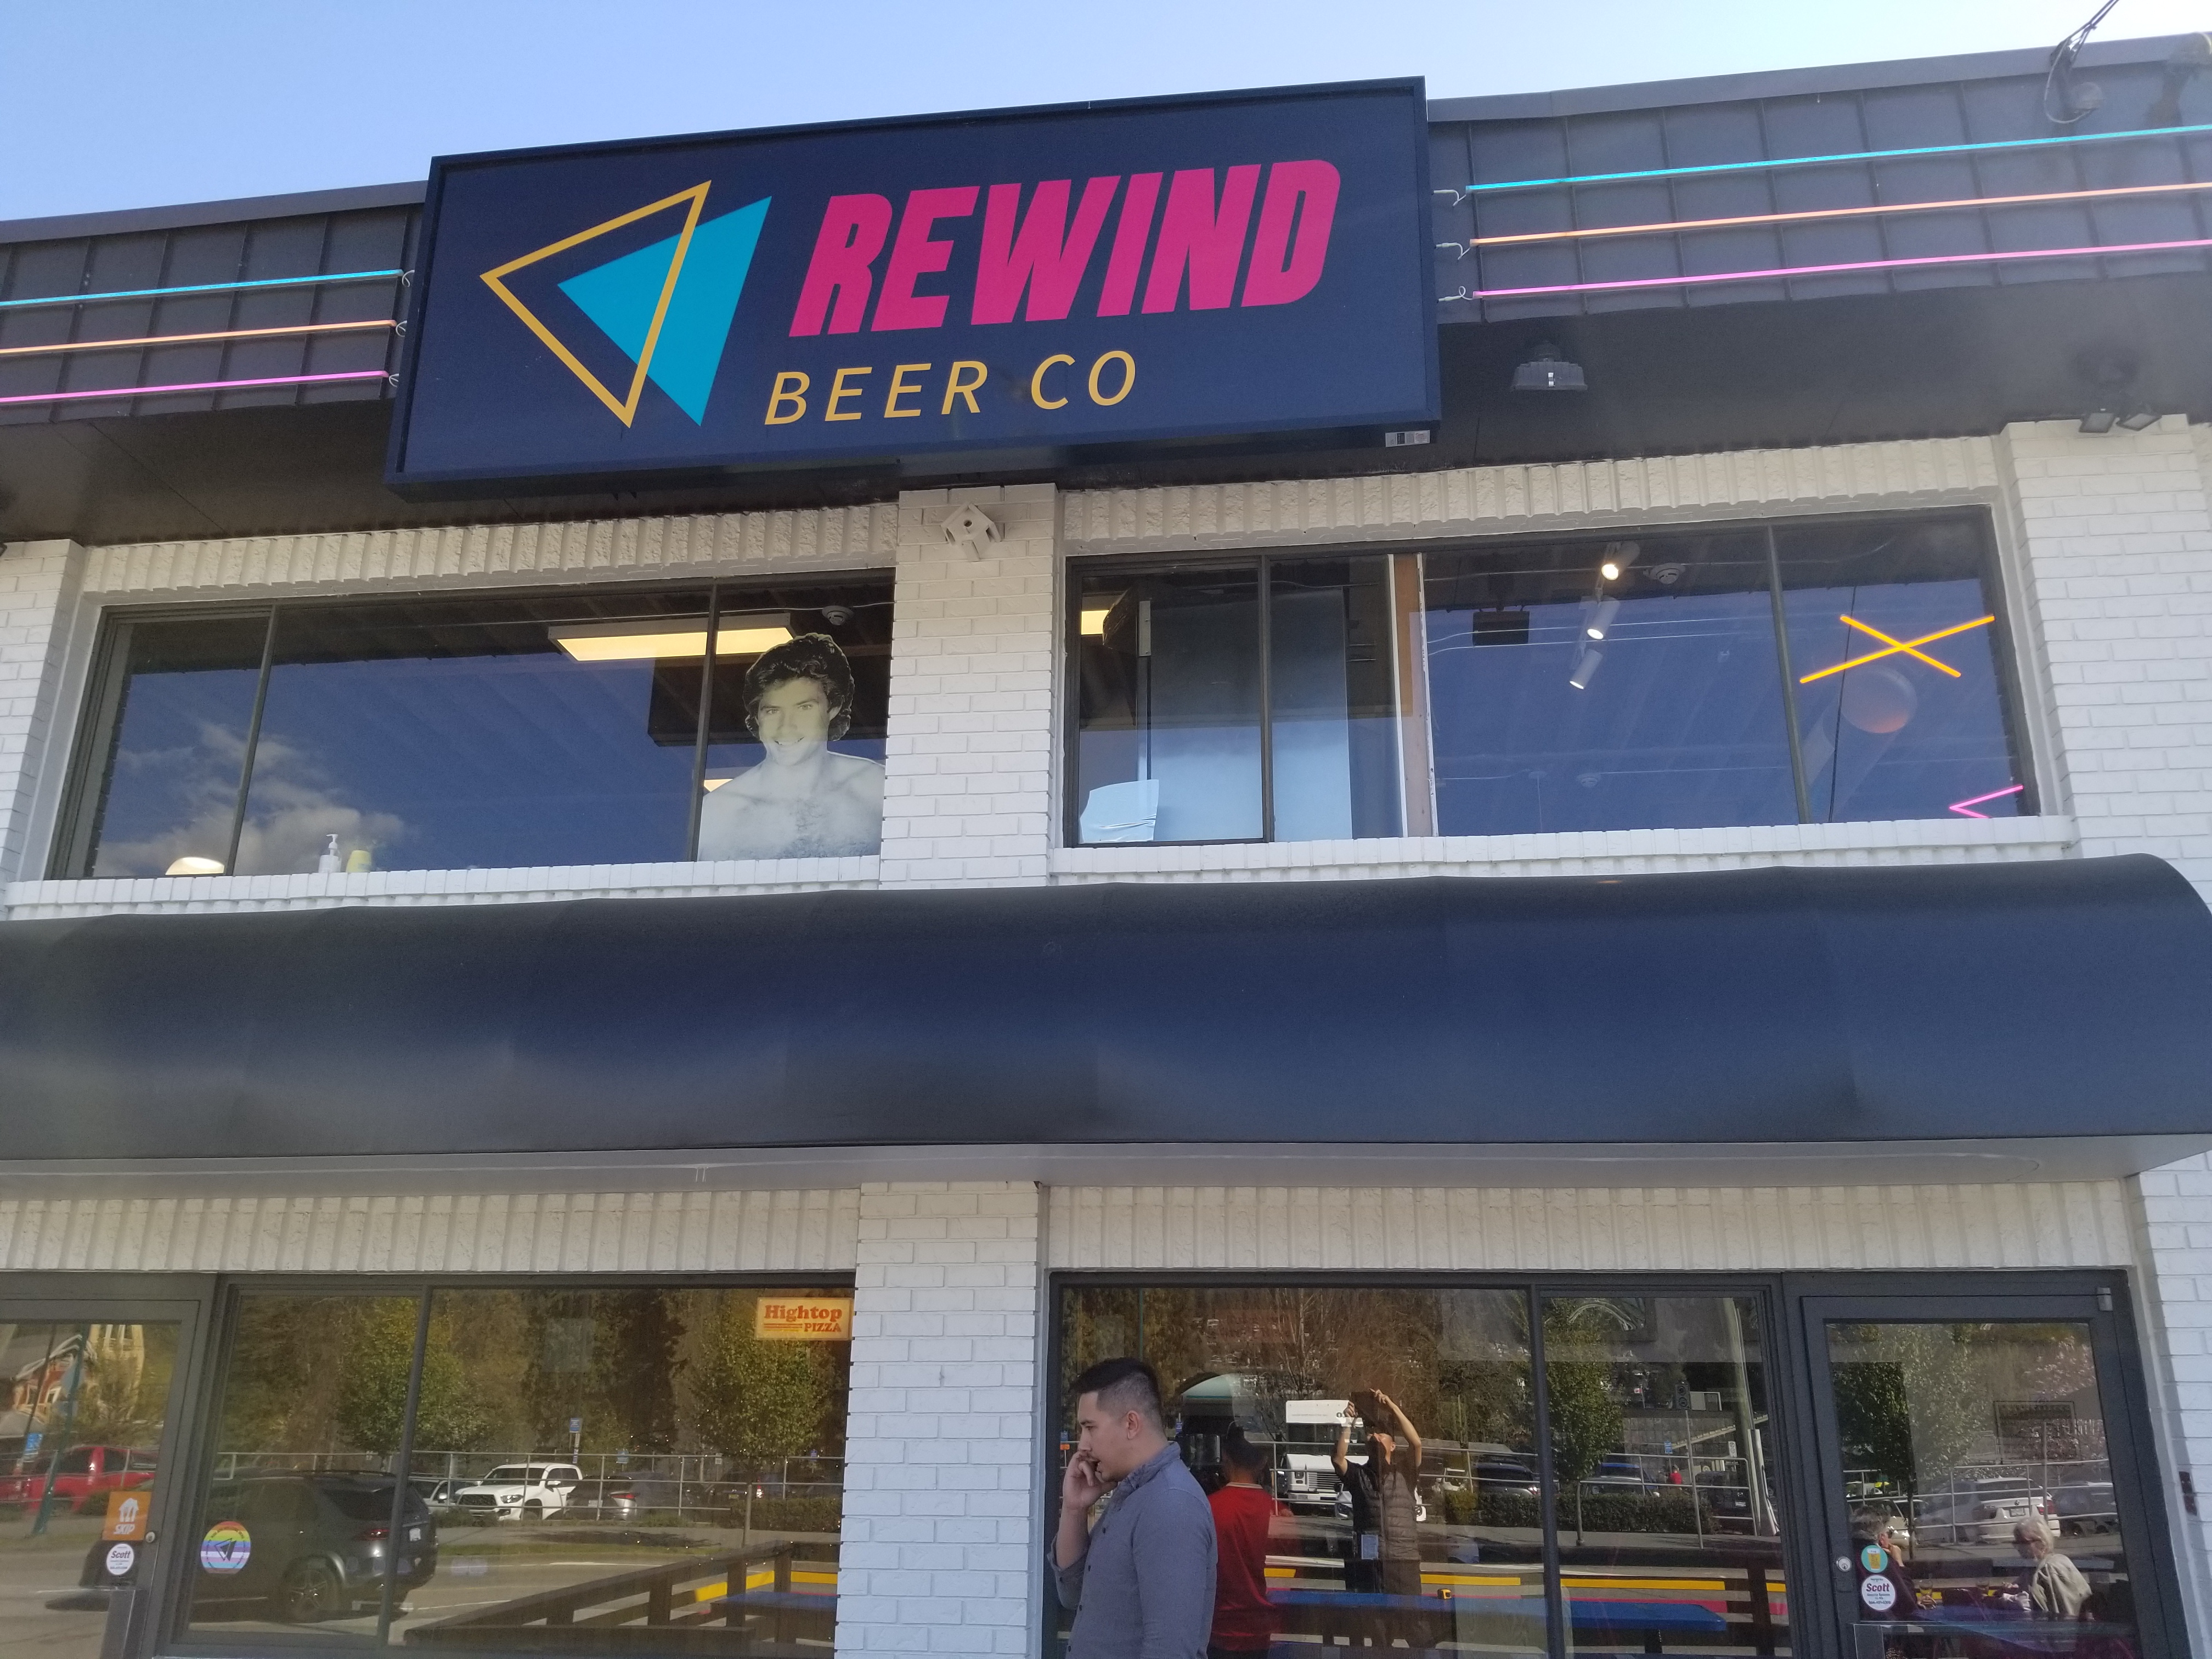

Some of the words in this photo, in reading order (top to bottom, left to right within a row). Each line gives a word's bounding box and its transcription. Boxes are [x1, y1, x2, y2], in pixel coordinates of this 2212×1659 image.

[788, 159, 1340, 337] REWIND
[765, 360, 987, 425] BEER
[1031, 351, 1135, 409] CO
[764, 1305, 843, 1323] Hightop
[804, 1323, 842, 1332] PIZZA
[113, 1523, 136, 1534] SKIP
[111, 1550, 131, 1559] Scott
[1866, 1583, 1890, 1592] Scott
